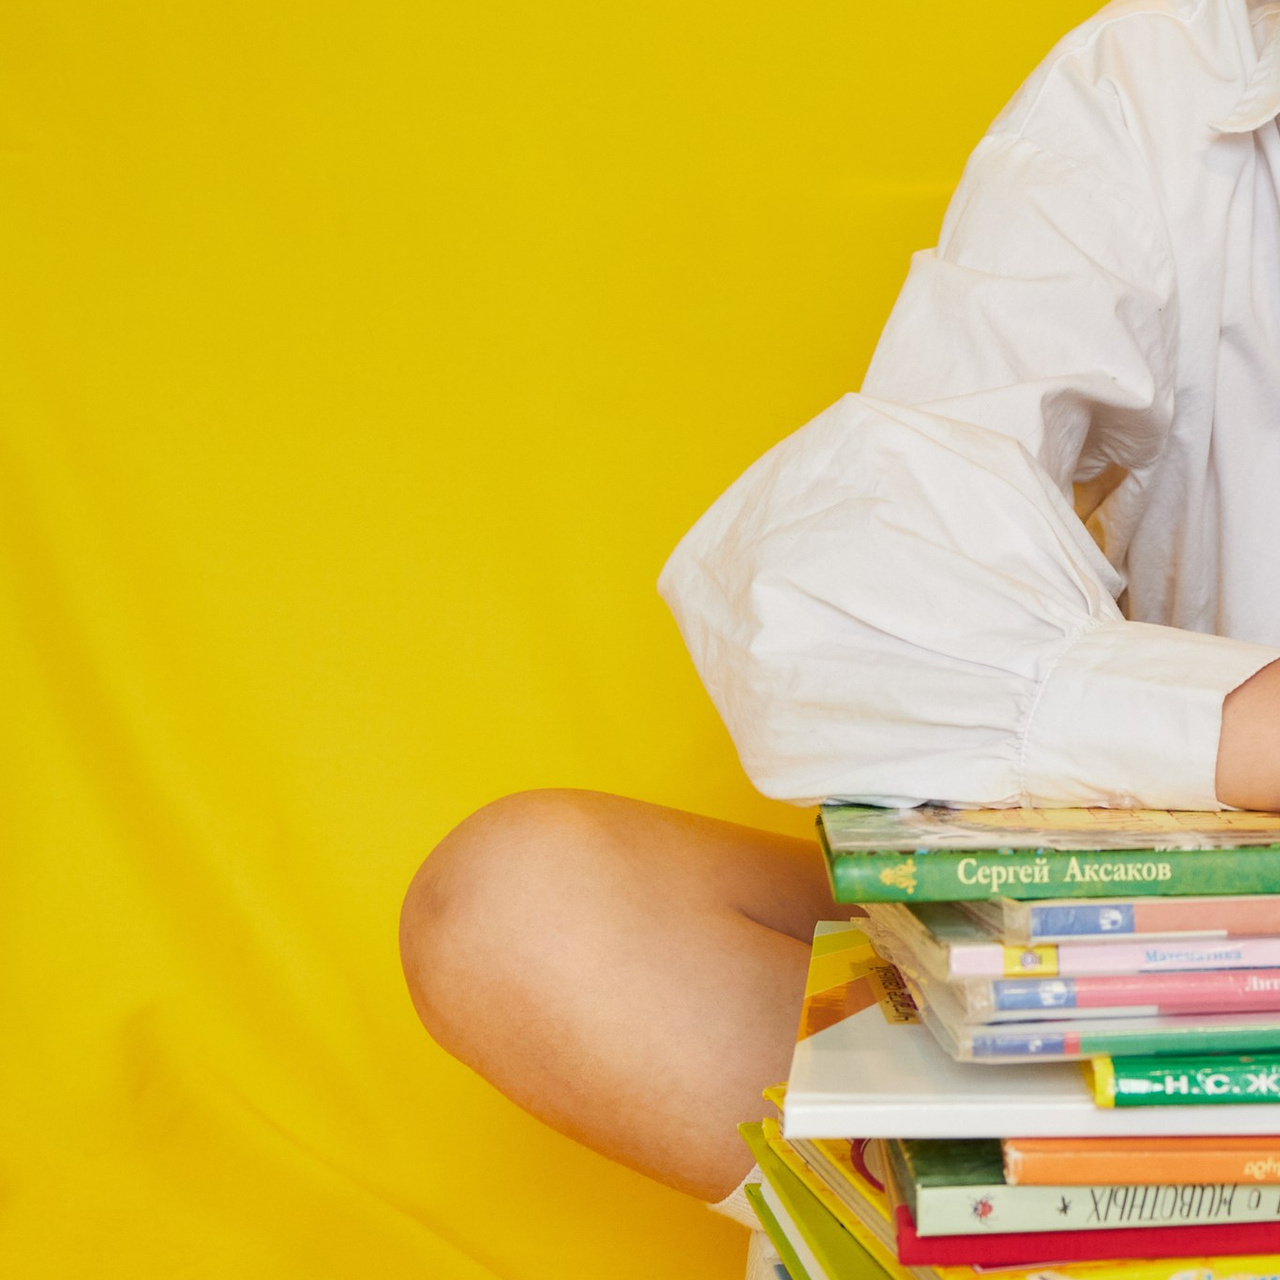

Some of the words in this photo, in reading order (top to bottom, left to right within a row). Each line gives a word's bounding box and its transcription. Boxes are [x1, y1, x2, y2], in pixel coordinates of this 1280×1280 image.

[957, 856, 1050, 889] Сергей
[1064, 856, 1172, 884] Аксаков
[1087, 1182, 1238, 1224] ЖИВОТНЫХ
